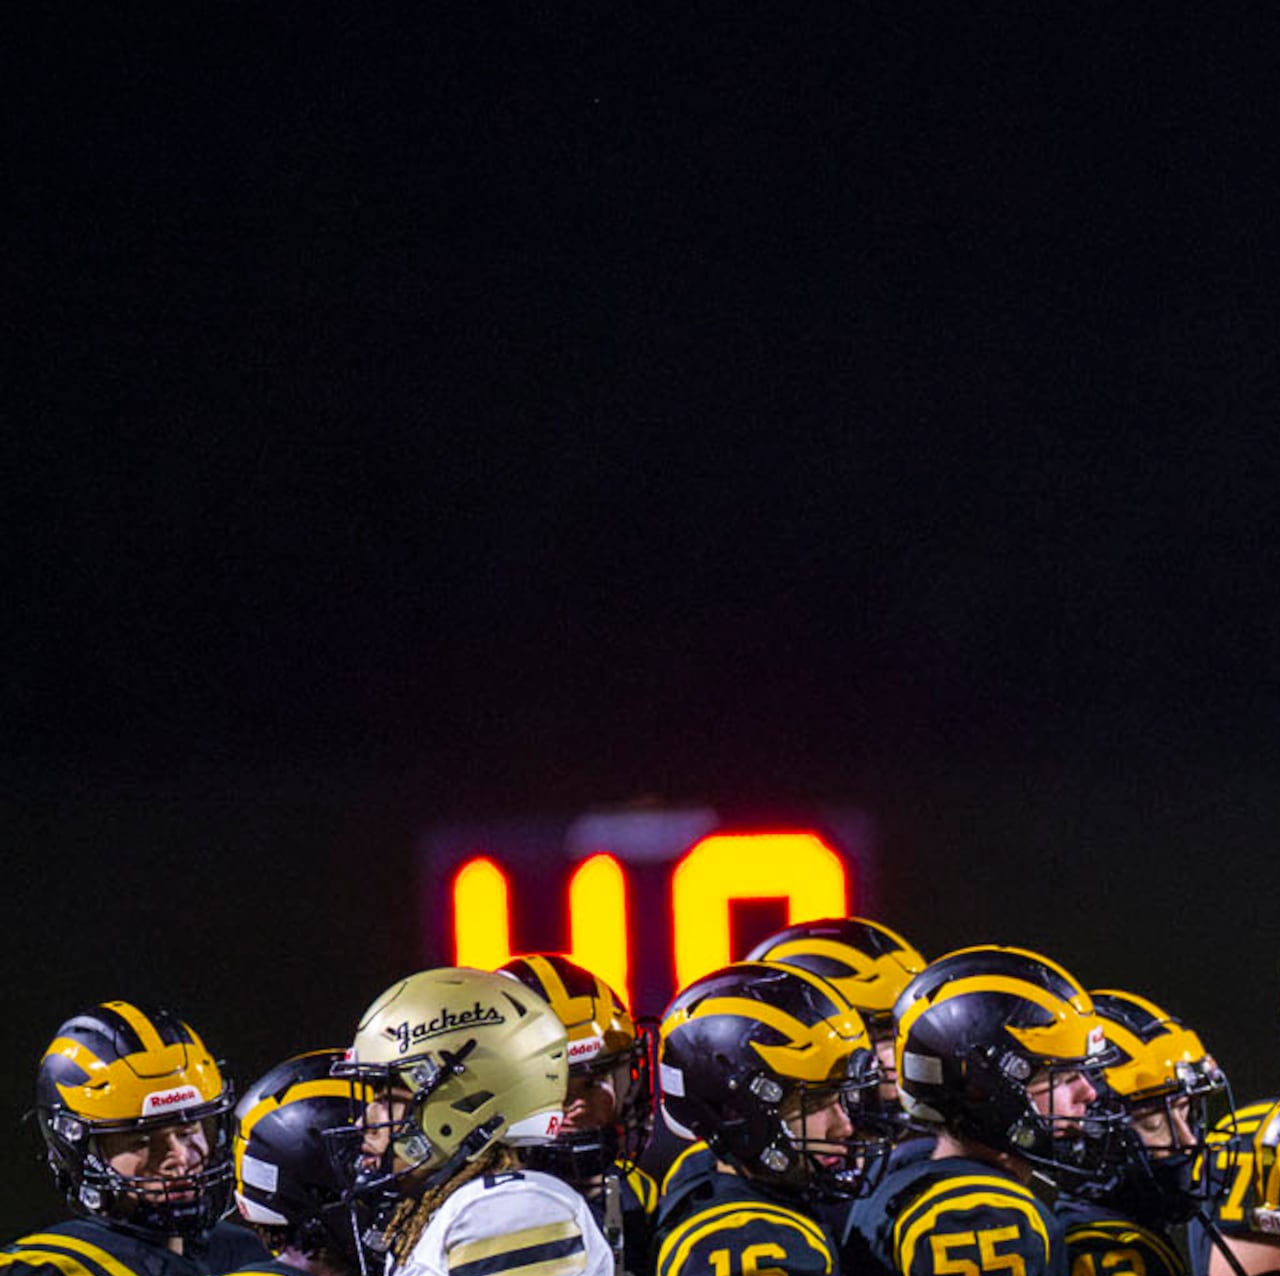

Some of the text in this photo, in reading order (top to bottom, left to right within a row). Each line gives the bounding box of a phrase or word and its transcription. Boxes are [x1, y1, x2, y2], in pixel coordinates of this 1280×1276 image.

[397, 1003, 505, 1053] Jackets
[569, 1041, 601, 1056] ddell
[151, 1090, 195, 1107] Riddell
